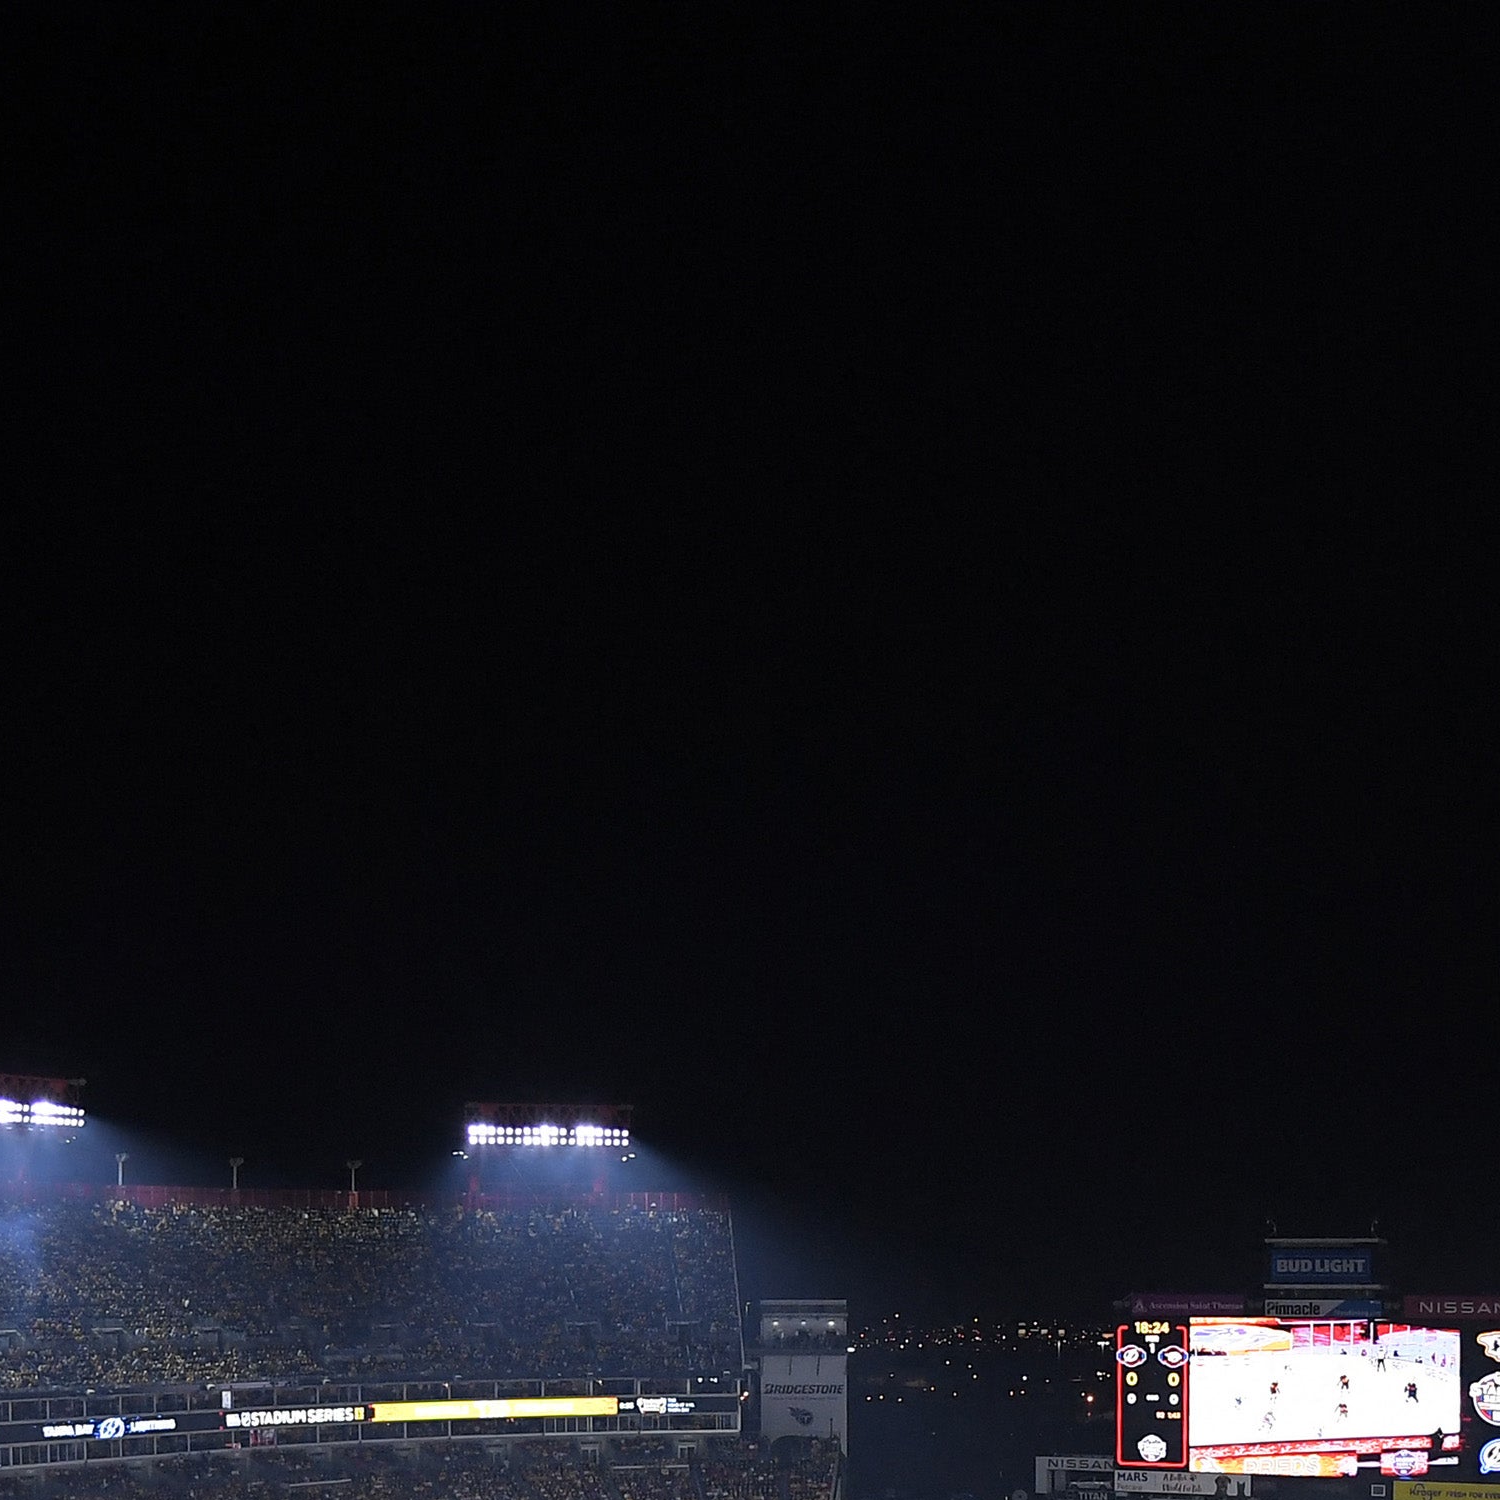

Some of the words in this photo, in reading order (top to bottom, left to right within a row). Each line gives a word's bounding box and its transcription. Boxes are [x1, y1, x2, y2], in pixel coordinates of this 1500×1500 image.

[1276, 1258, 1313, 1273] BUD
[1315, 1258, 1366, 1273] LIGHT
[1210, 1301, 1244, 1310] Thomas
[1266, 1302, 1321, 1316] Pinnacle
[1134, 1322, 1170, 1334] 18:24
[1126, 1372, 1138, 1386] 0
[1167, 1372, 1180, 1386] 0
[763, 1383, 844, 1395] BRIDGESTONE
[251, 1409, 307, 1427] STADIUM
[308, 1407, 354, 1423] SERIES
[1048, 1459, 1115, 1470] NISSAN
[1117, 1472, 1148, 1482] MARS
[1078, 1492, 1109, 1500] TITAN
[1445, 1491, 1467, 1499] FRESH
[1468, 1491, 1483, 1500] FOR
